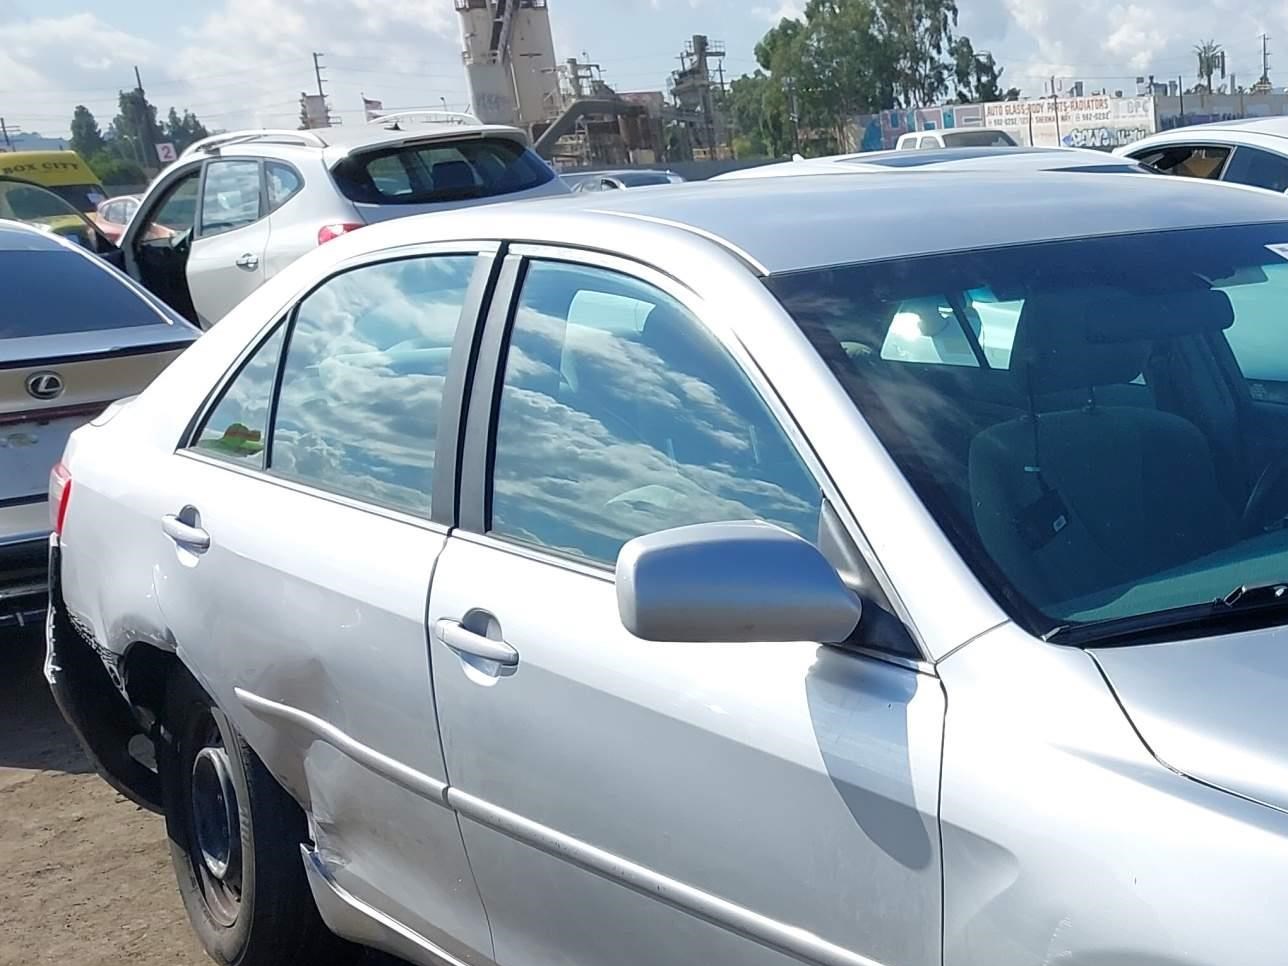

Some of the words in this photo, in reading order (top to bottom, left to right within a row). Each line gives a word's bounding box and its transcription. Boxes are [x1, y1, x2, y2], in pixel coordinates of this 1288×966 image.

[987, 104, 1003, 117] AUTO
[162, 145, 173, 159] 2
[2, 163, 37, 174] BOX
[42, 161, 79, 170] CITY
